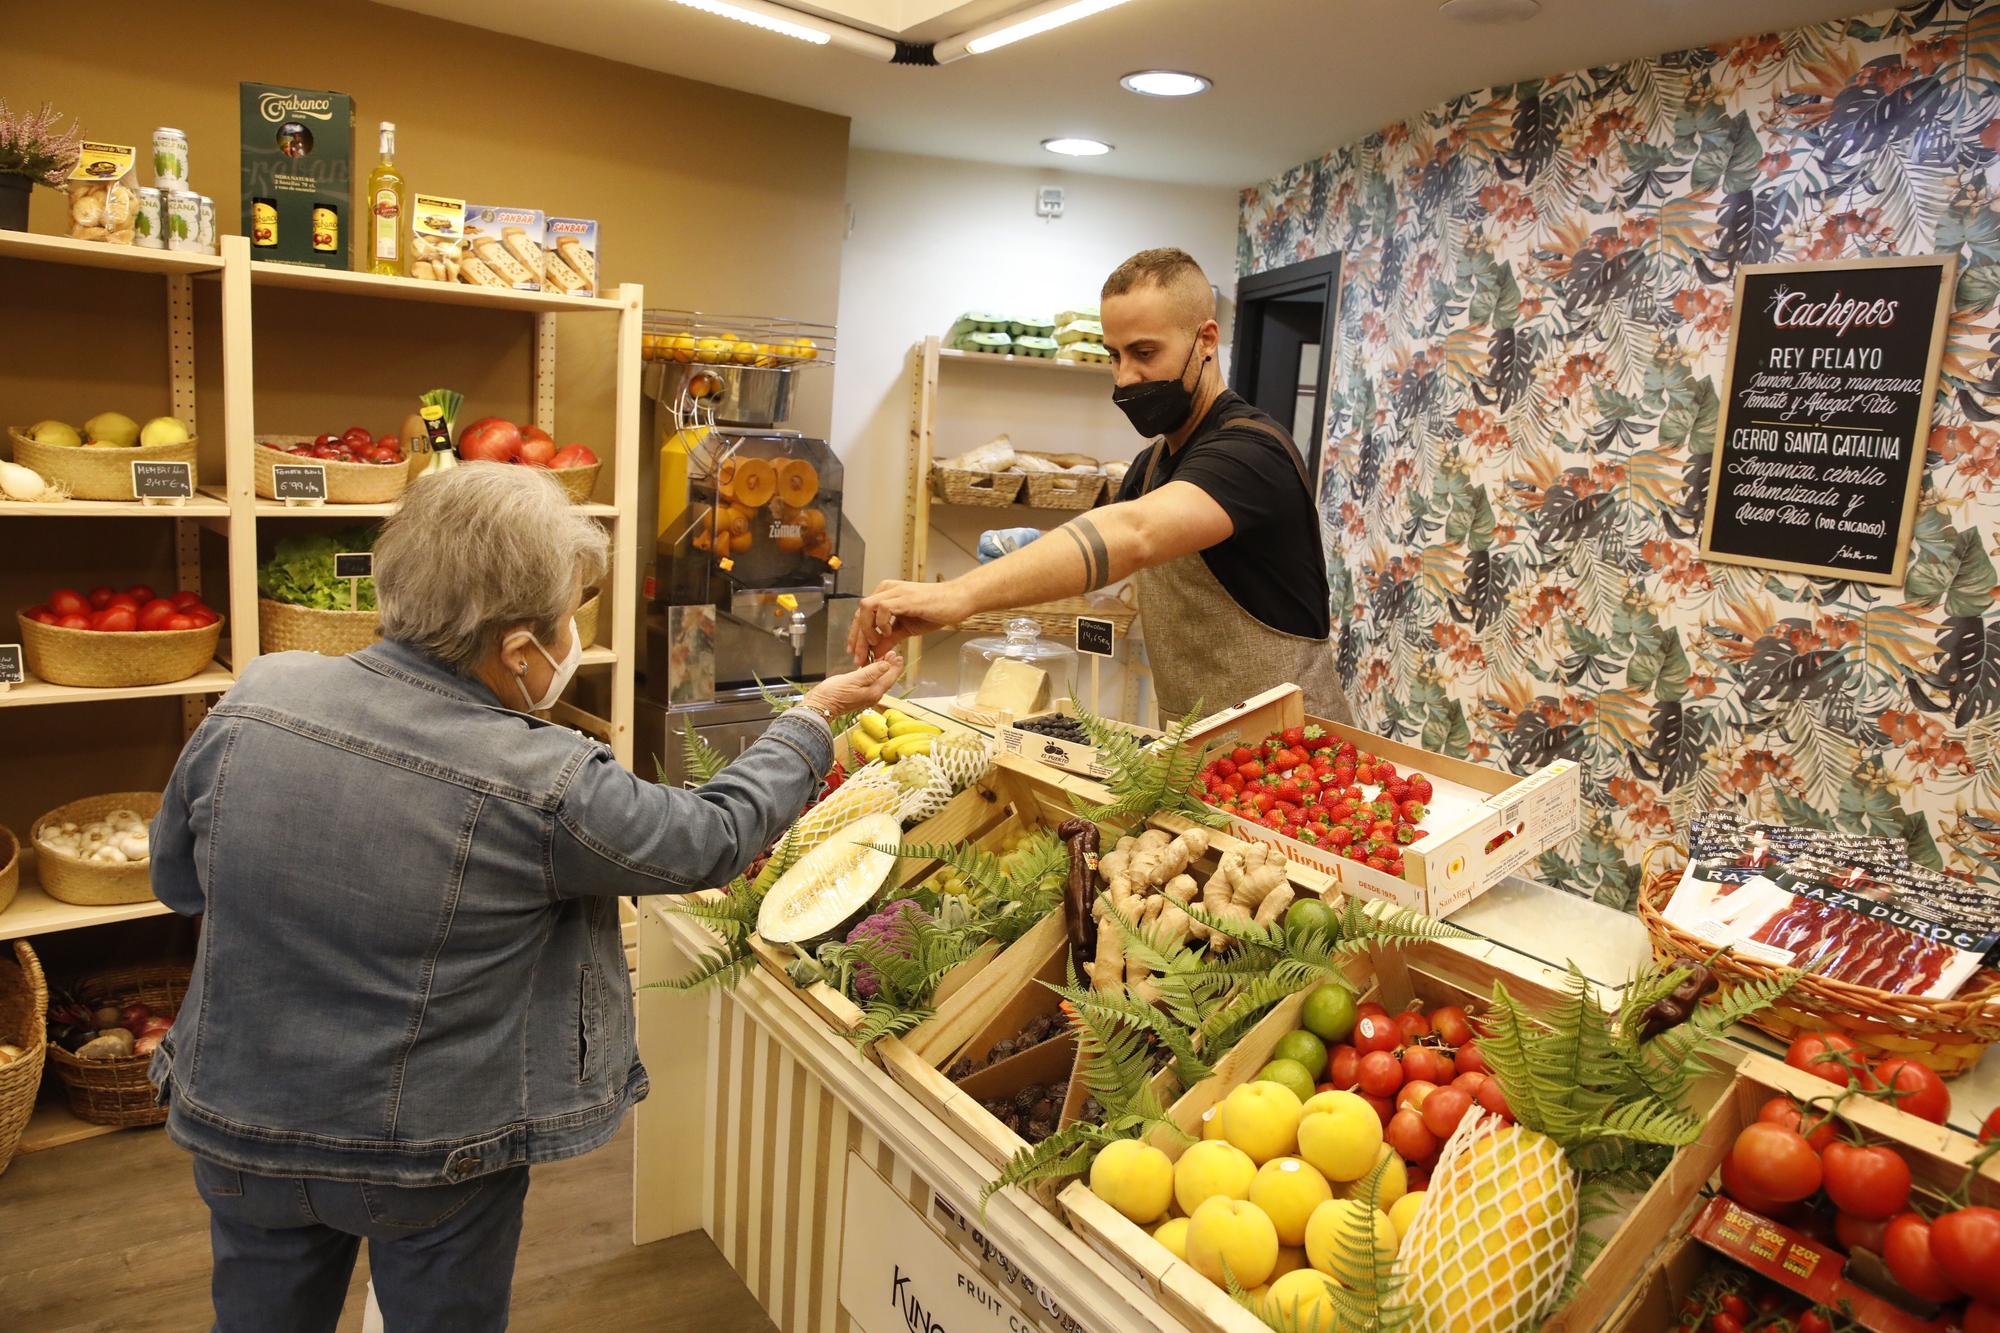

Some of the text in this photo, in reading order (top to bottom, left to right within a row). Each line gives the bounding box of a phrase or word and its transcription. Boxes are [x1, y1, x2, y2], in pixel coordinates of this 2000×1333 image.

[258, 92, 333, 123] Trabanco
[498, 212, 536, 225] SANBAR
[552, 222, 588, 233] SANBAR
[1773, 291, 1899, 337] Cachopos
[1769, 347, 1883, 370] REY PELAYO
[1747, 371, 1795, 391] Jamón
[1844, 376, 1923, 396] manzana,
[1780, 396, 1803, 421] y
[1732, 428, 1900, 461] CERRO SANTA CATALINA
[1822, 465, 1888, 486] cebolla
[1733, 482, 1866, 518] caramelizada y
[1735, 502, 1777, 526] Queso
[1815, 513, 1836, 530] (POR
[1358, 880, 1383, 894] DESDE
[1706, 870, 1756, 883] RAZ
[1790, 881, 1859, 911] RAZA
[1869, 906, 1975, 947] DUROC
[1789, 1243, 1821, 1264] 2021
[892, 1263, 947, 1333] KIN
[957, 1272, 1002, 1317] FRUIT
